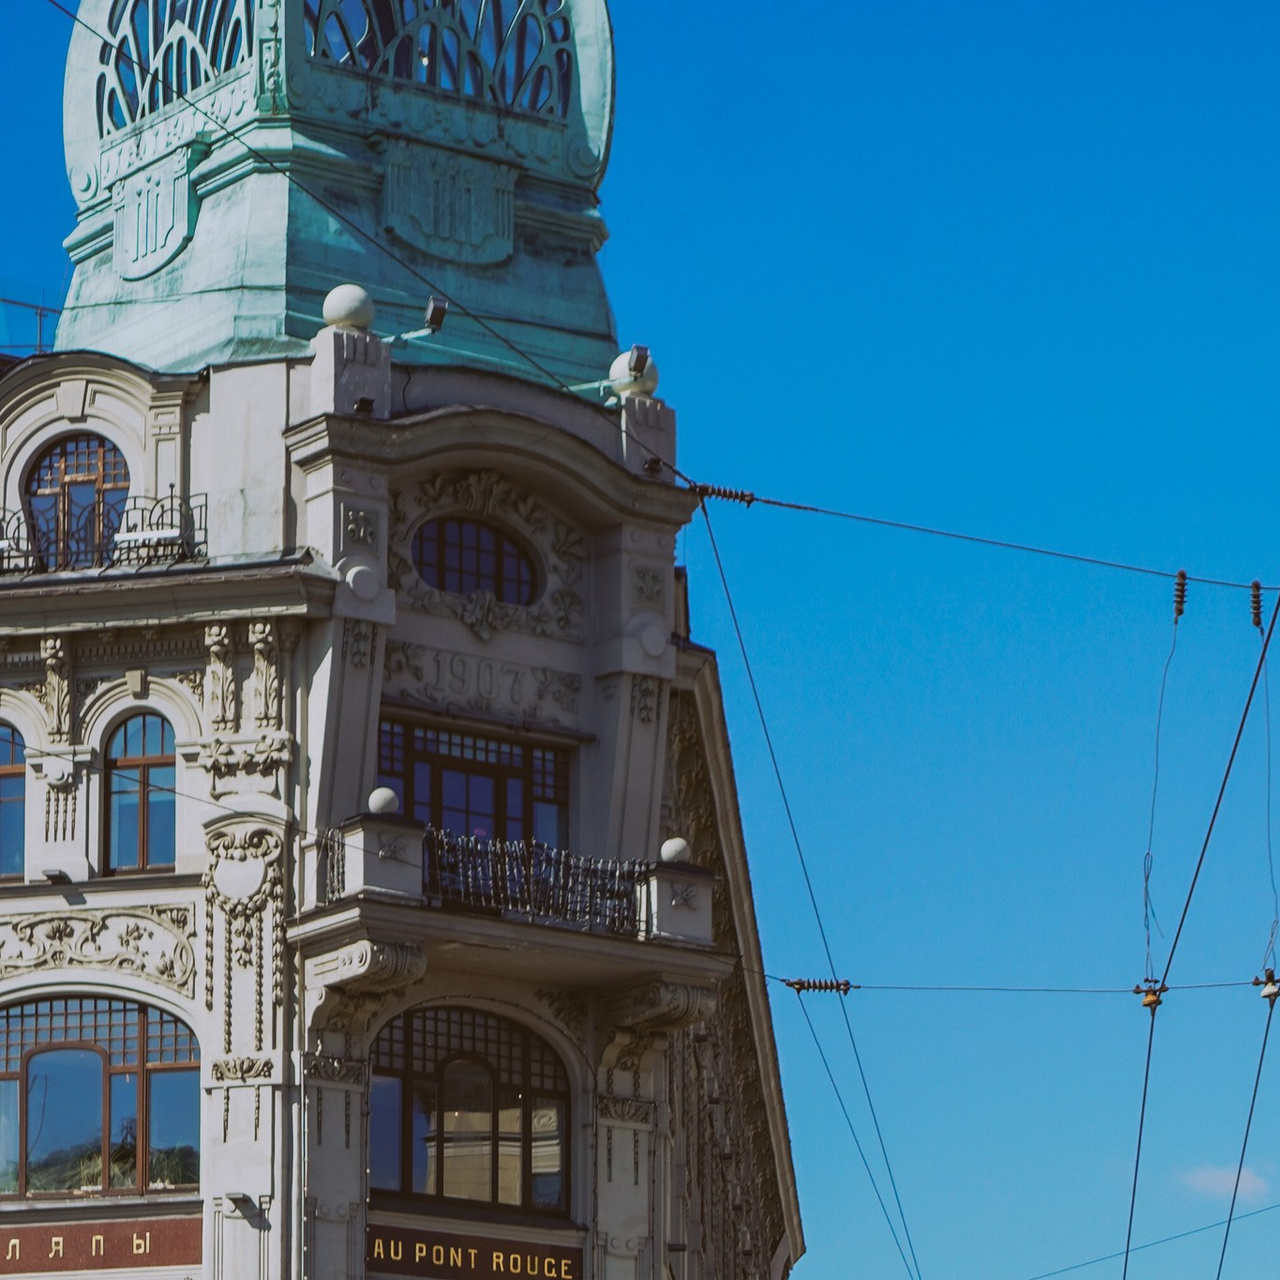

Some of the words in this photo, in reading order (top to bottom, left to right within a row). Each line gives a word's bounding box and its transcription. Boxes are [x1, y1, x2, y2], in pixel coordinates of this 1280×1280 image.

[373, 1238, 403, 1261] AU
[415, 1242, 478, 1270] PONT
[492, 1251, 573, 1280] ROUGE
